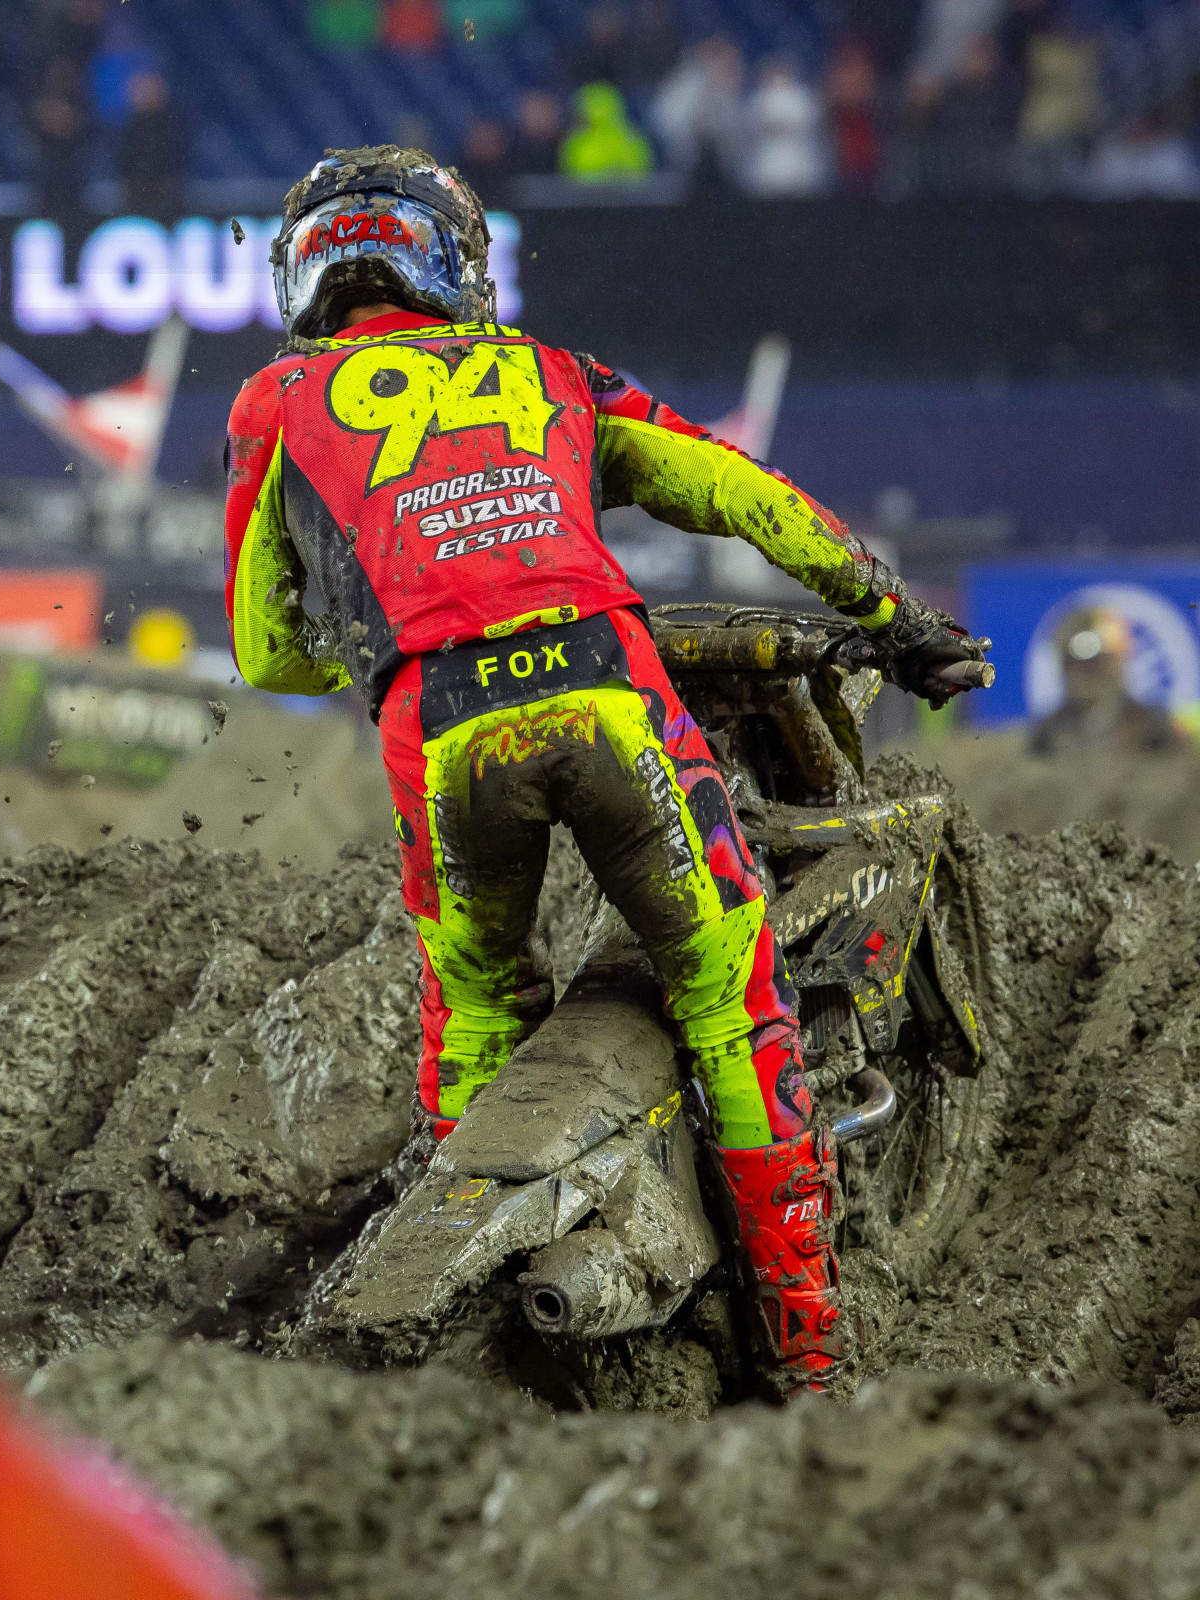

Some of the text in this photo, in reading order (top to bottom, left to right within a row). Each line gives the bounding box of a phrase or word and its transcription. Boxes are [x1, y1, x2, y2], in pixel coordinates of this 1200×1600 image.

[325, 341, 558, 500] 94
[419, 491, 561, 538] SUZUKI
[434, 518, 567, 561] ECSTAR
[476, 642, 569, 687] FOX
